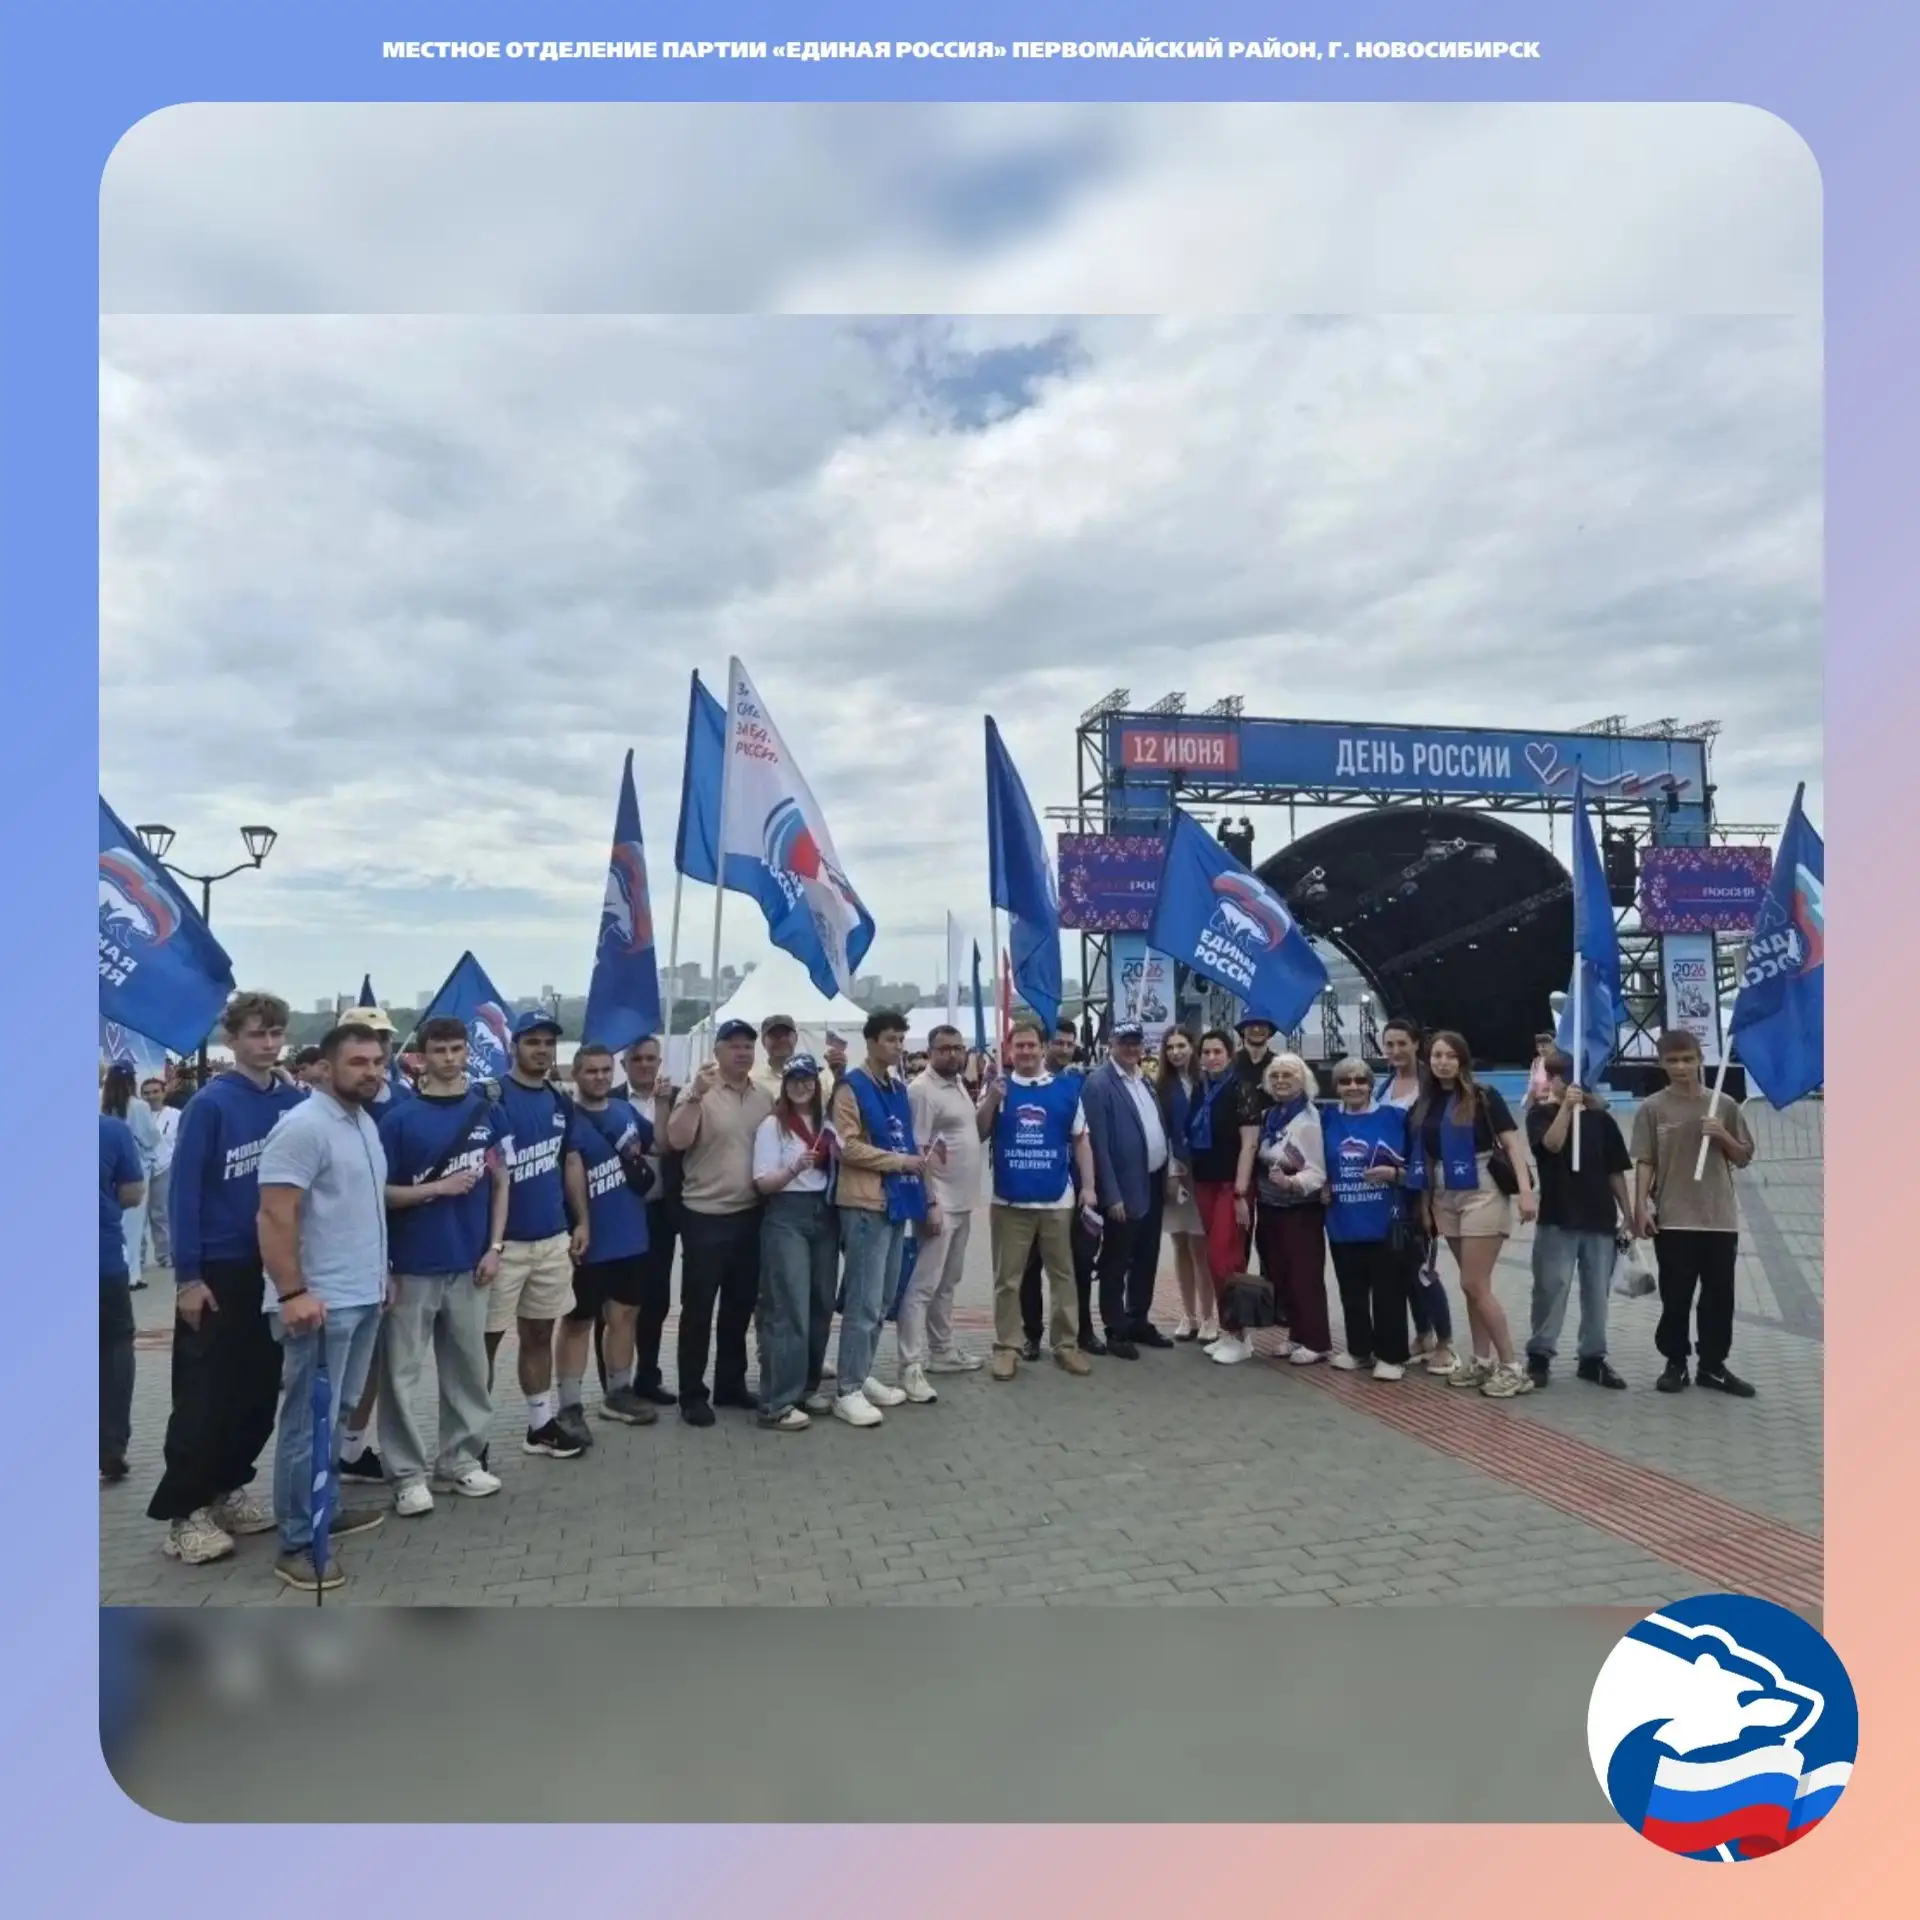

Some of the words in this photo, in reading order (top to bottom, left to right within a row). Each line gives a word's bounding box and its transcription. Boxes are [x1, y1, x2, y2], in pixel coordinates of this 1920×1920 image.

[1133, 736, 1157, 763] 12
[1163, 736, 1225, 764] ИЮНЯ
[1335, 739, 1404, 777] ДЕНЬ
[1413, 743, 1511, 779] РОССИИ
[1194, 944, 1253, 991] РОССИЯ
[1200, 928, 1257, 977] ЕДИНАЯ
[1673, 963, 1706, 978] 2026
